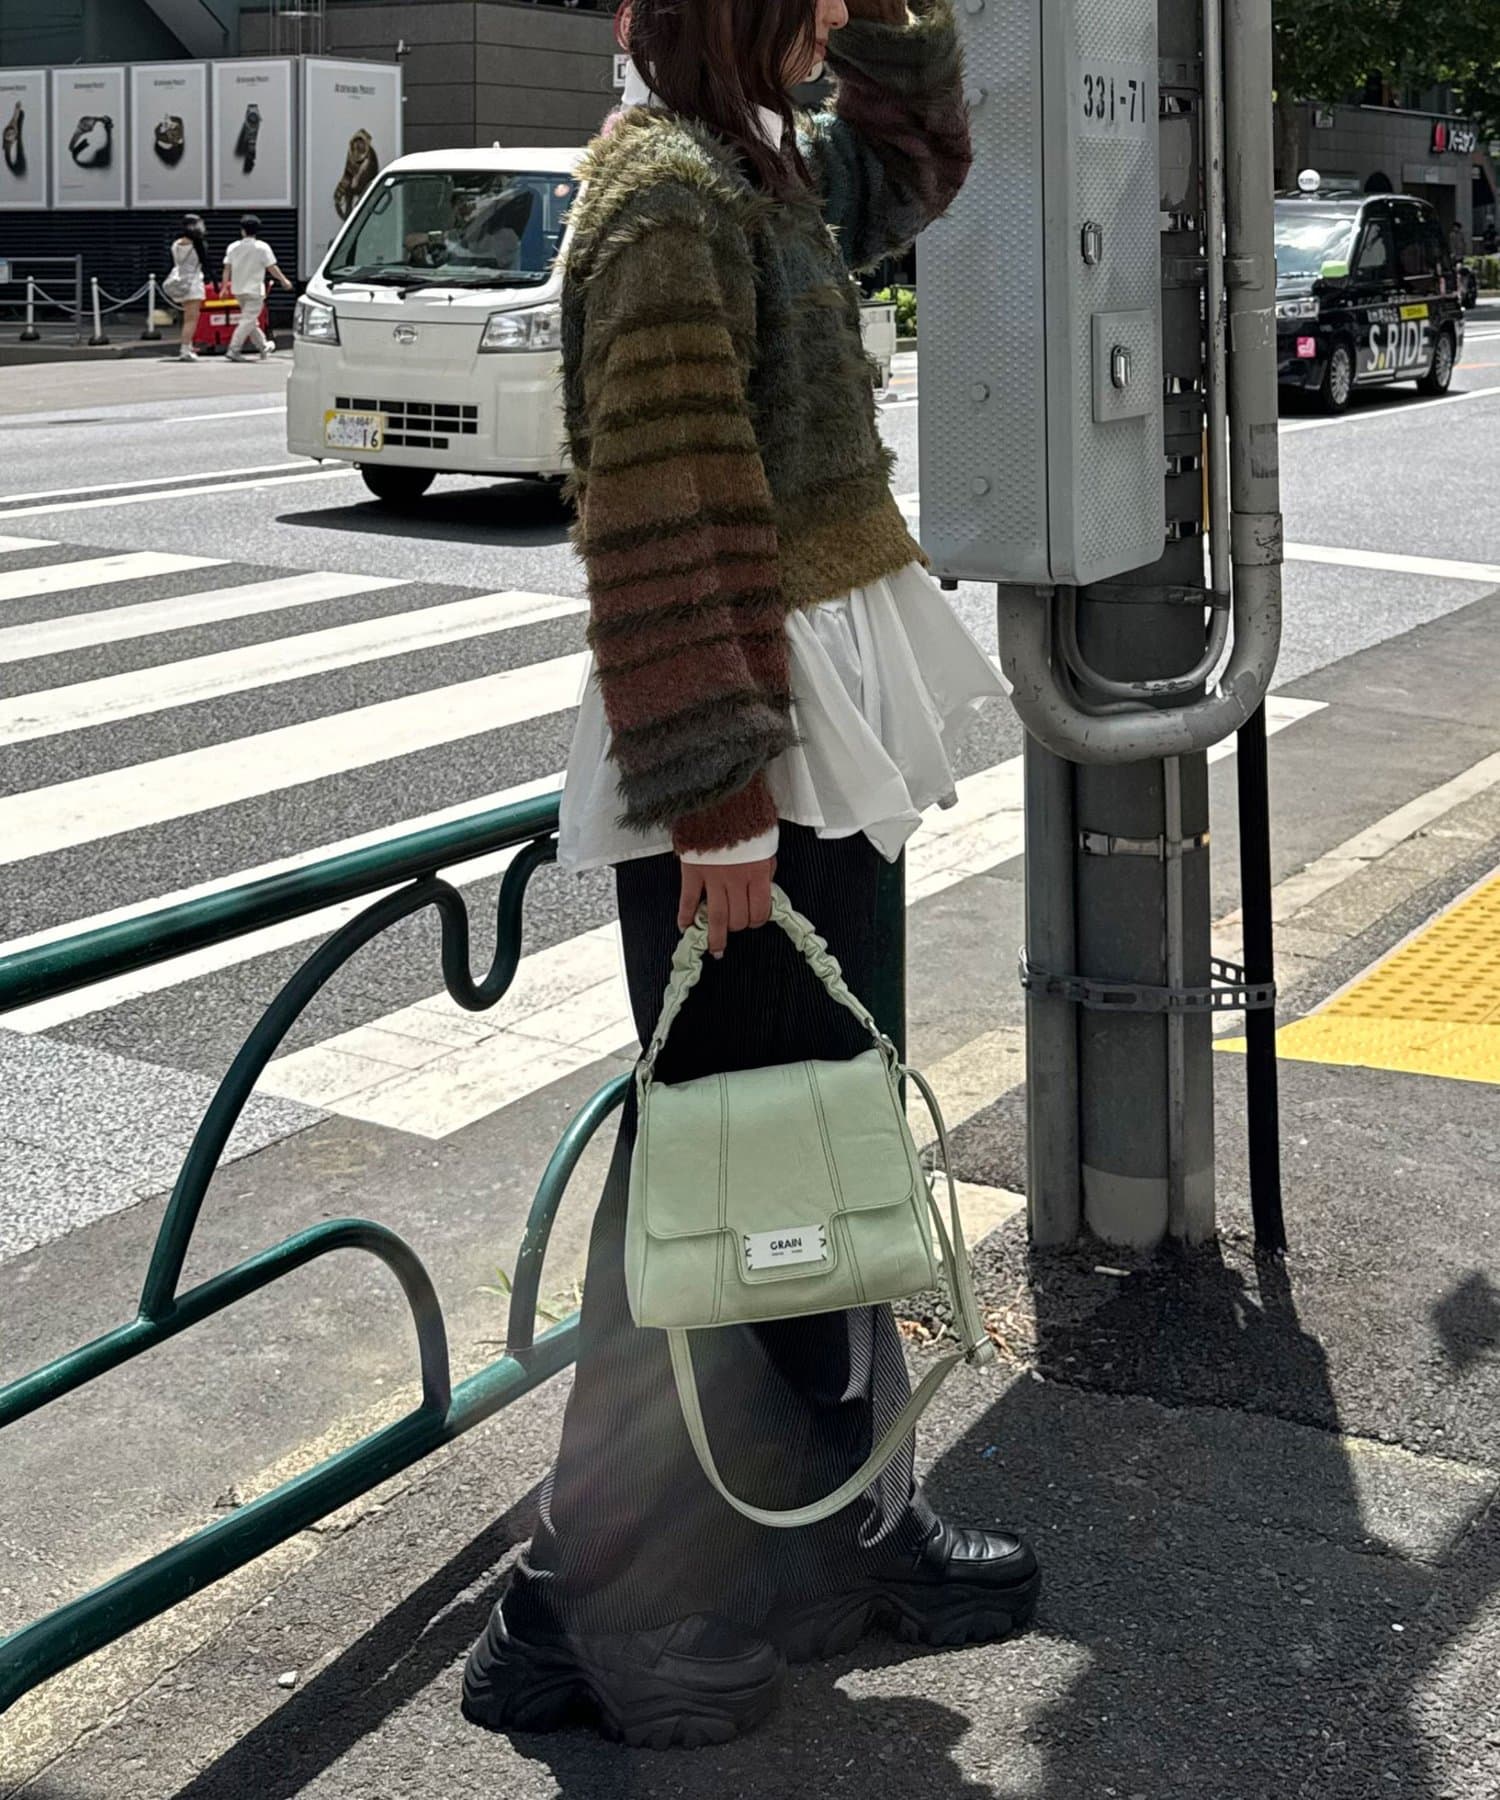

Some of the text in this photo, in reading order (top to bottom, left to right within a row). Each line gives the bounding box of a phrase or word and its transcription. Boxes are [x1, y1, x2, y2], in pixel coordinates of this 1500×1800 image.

[1084, 74, 1145, 123] 331-71
[1367, 319, 1430, 371] S.RIDE
[770, 1237, 802, 1250] GRAIN
